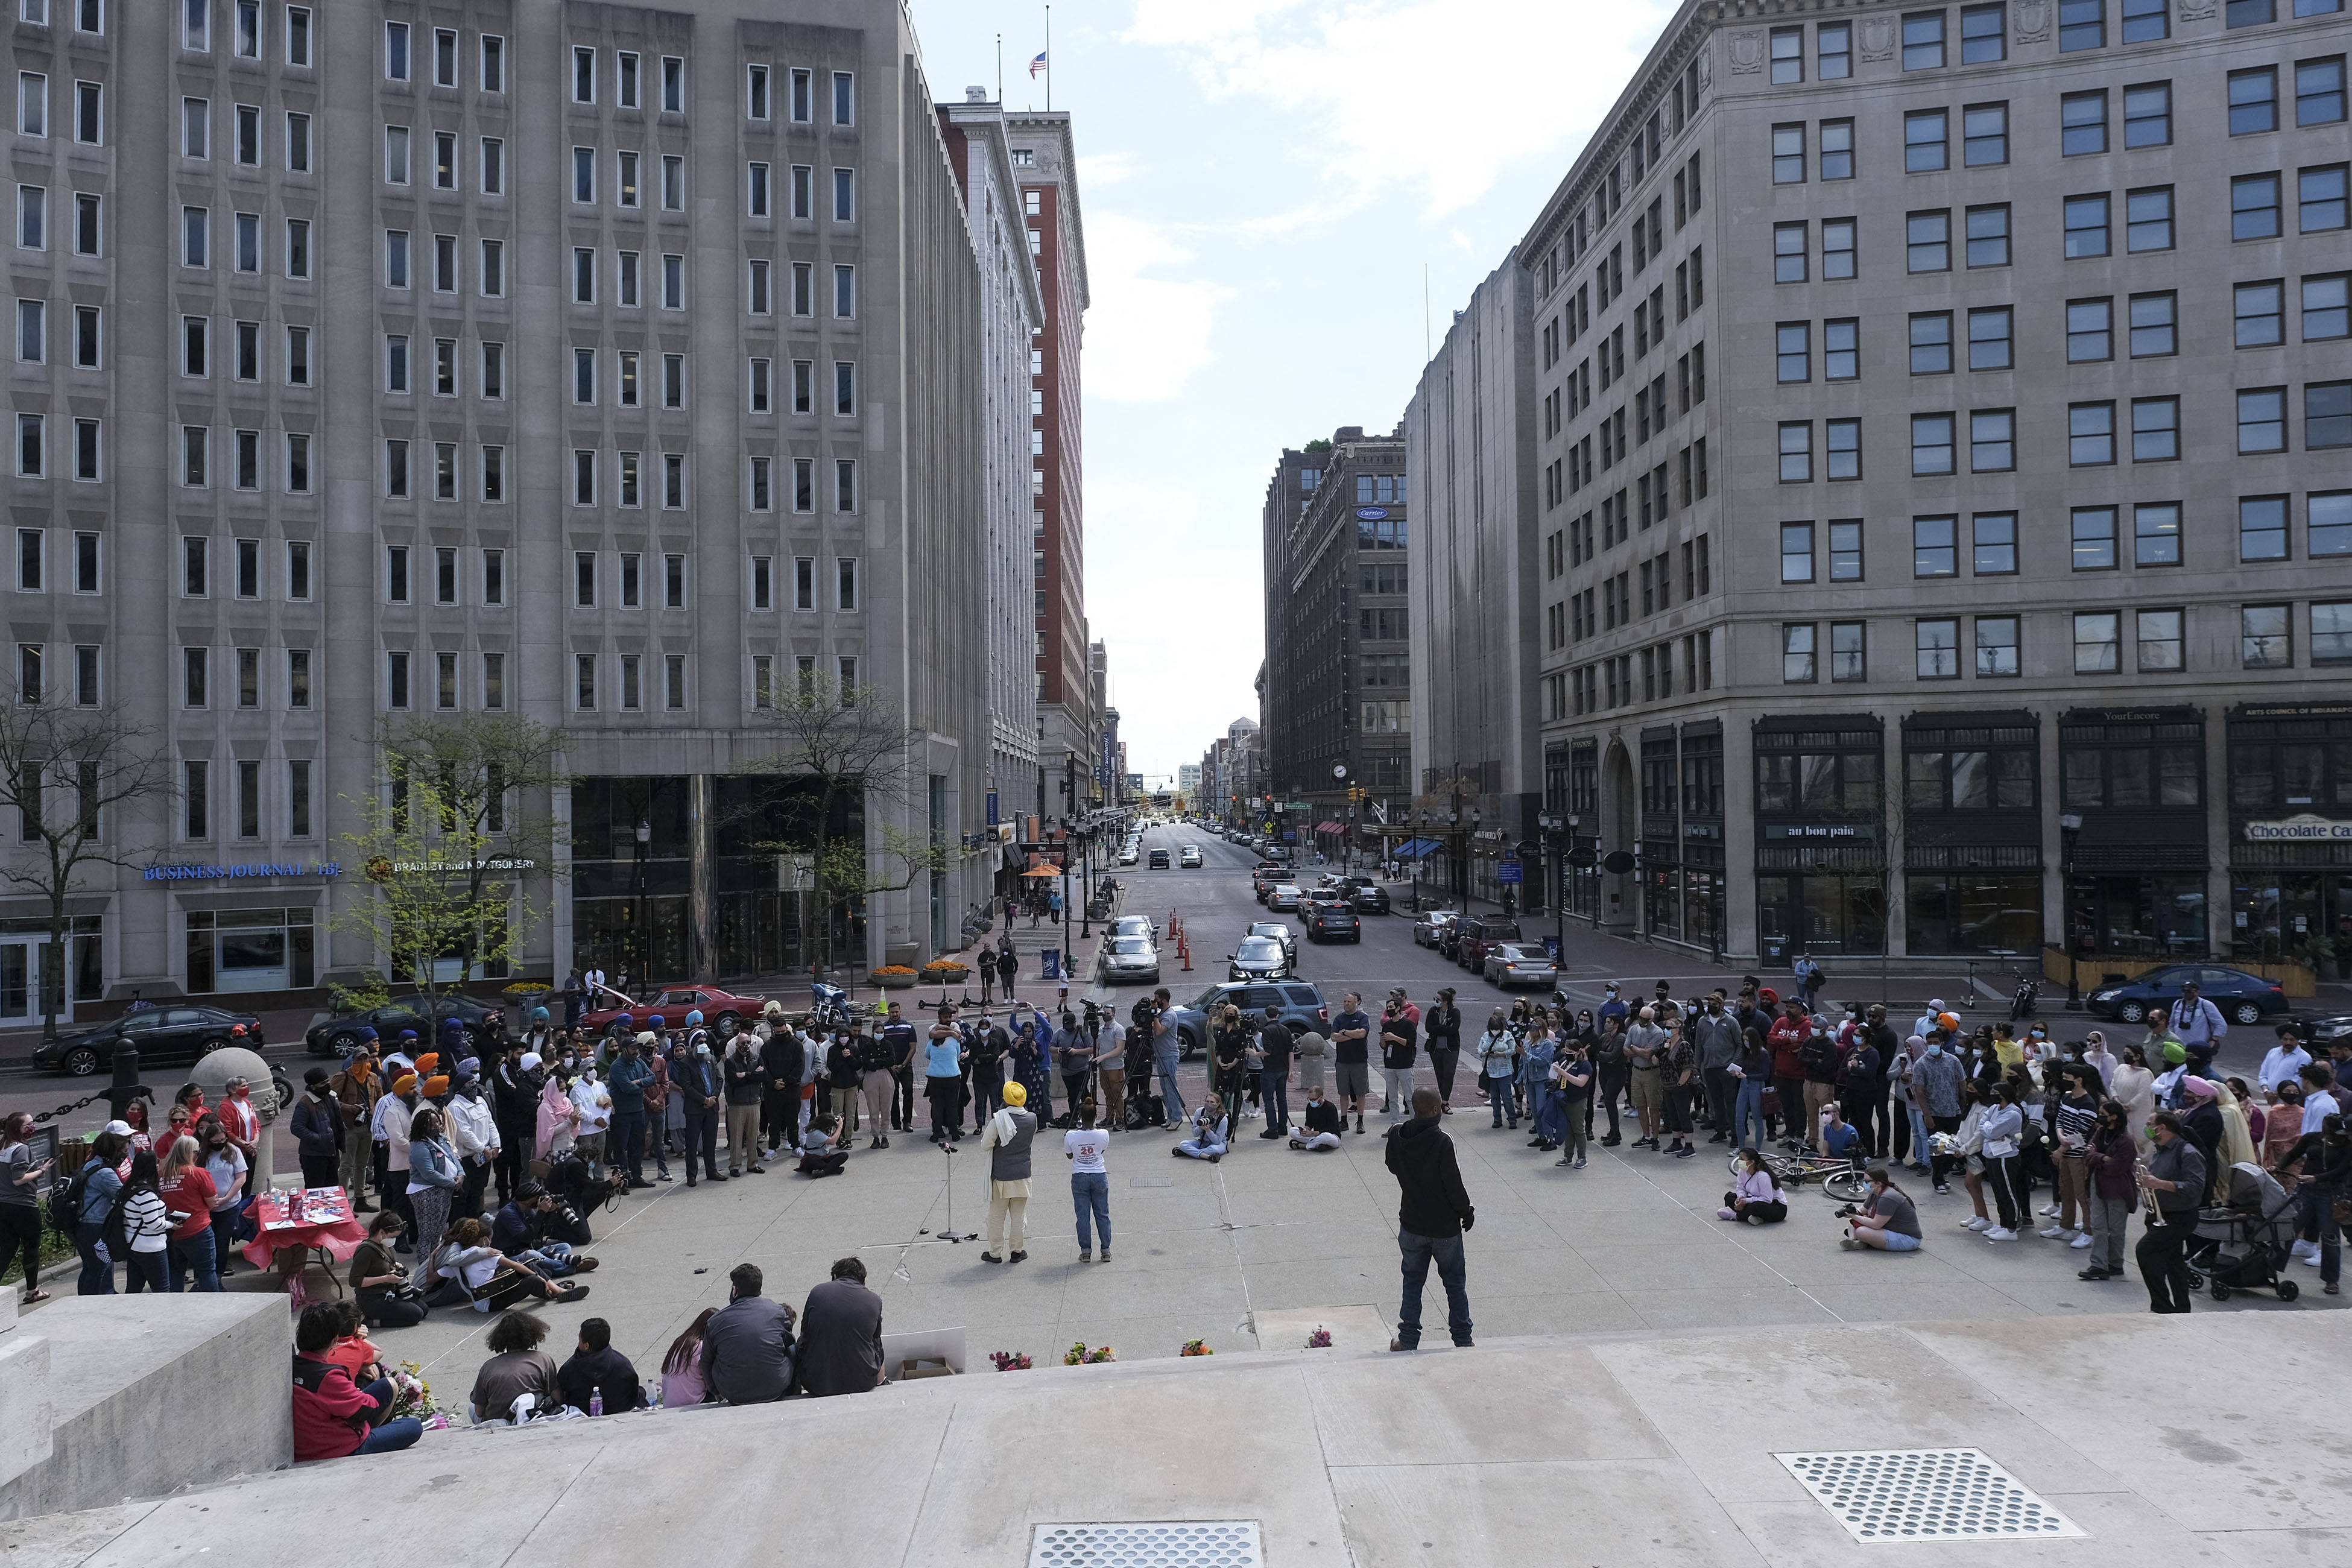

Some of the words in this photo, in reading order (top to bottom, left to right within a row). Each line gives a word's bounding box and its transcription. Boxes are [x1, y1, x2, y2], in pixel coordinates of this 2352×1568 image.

[1806, 826, 1826, 836] bon
[1830, 826, 1854, 838] pain
[2251, 825, 2327, 837] Chocolate
[2331, 826, 2352, 837] Ca
[144, 865, 224, 880] BUSINESS
[229, 863, 305, 880] JOURNAL
[317, 862, 340, 877] IBJ
[446, 862, 464, 870] and
